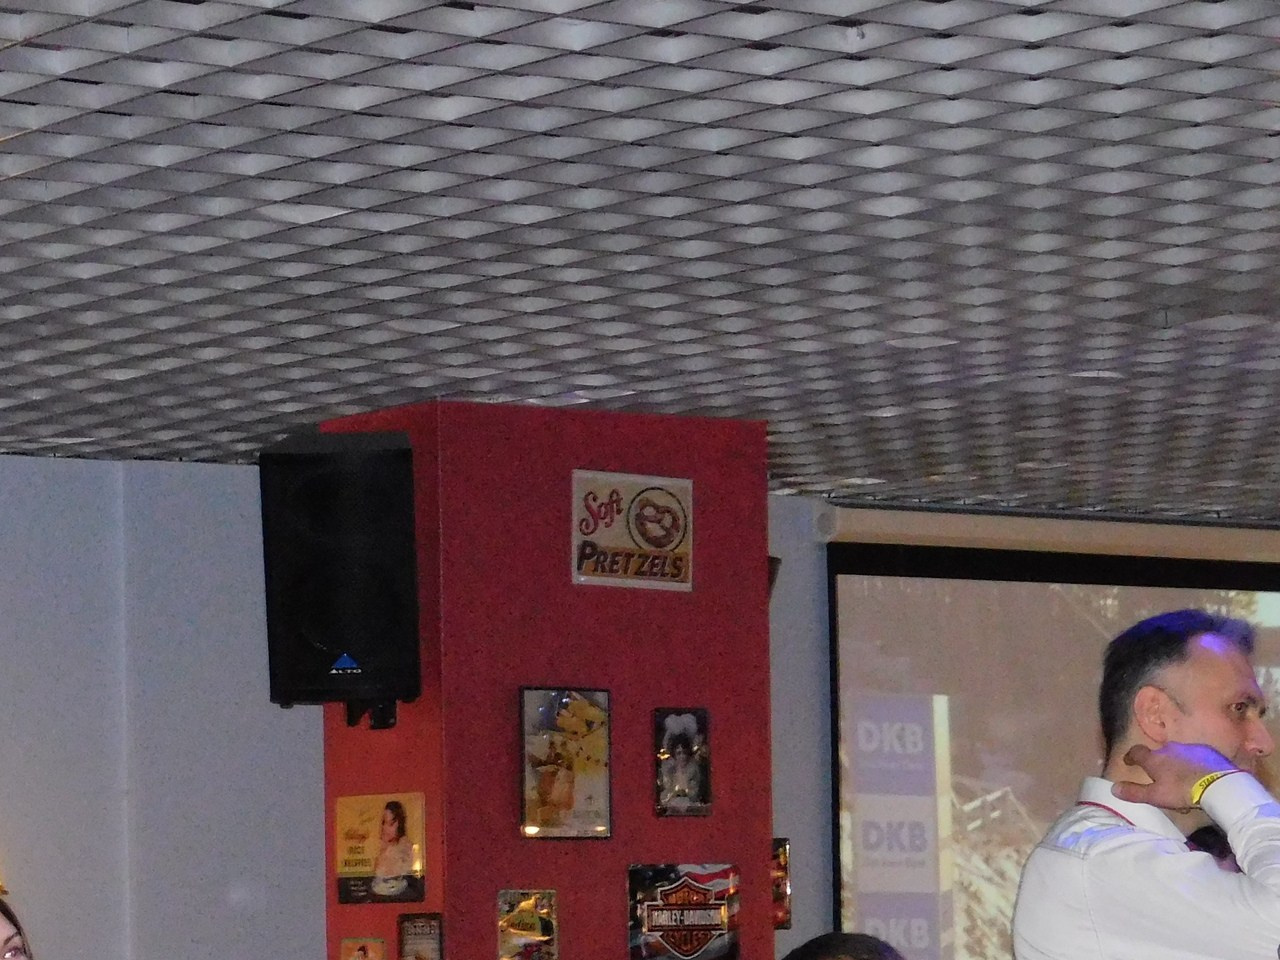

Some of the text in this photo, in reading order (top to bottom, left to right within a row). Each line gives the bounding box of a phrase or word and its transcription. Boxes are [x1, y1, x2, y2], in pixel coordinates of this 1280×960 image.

[579, 488, 624, 536] Soft
[576, 540, 687, 578] PRETZELS
[857, 721, 924, 753] DKB
[862, 820, 928, 853] DKB
[865, 917, 930, 949] DKB
